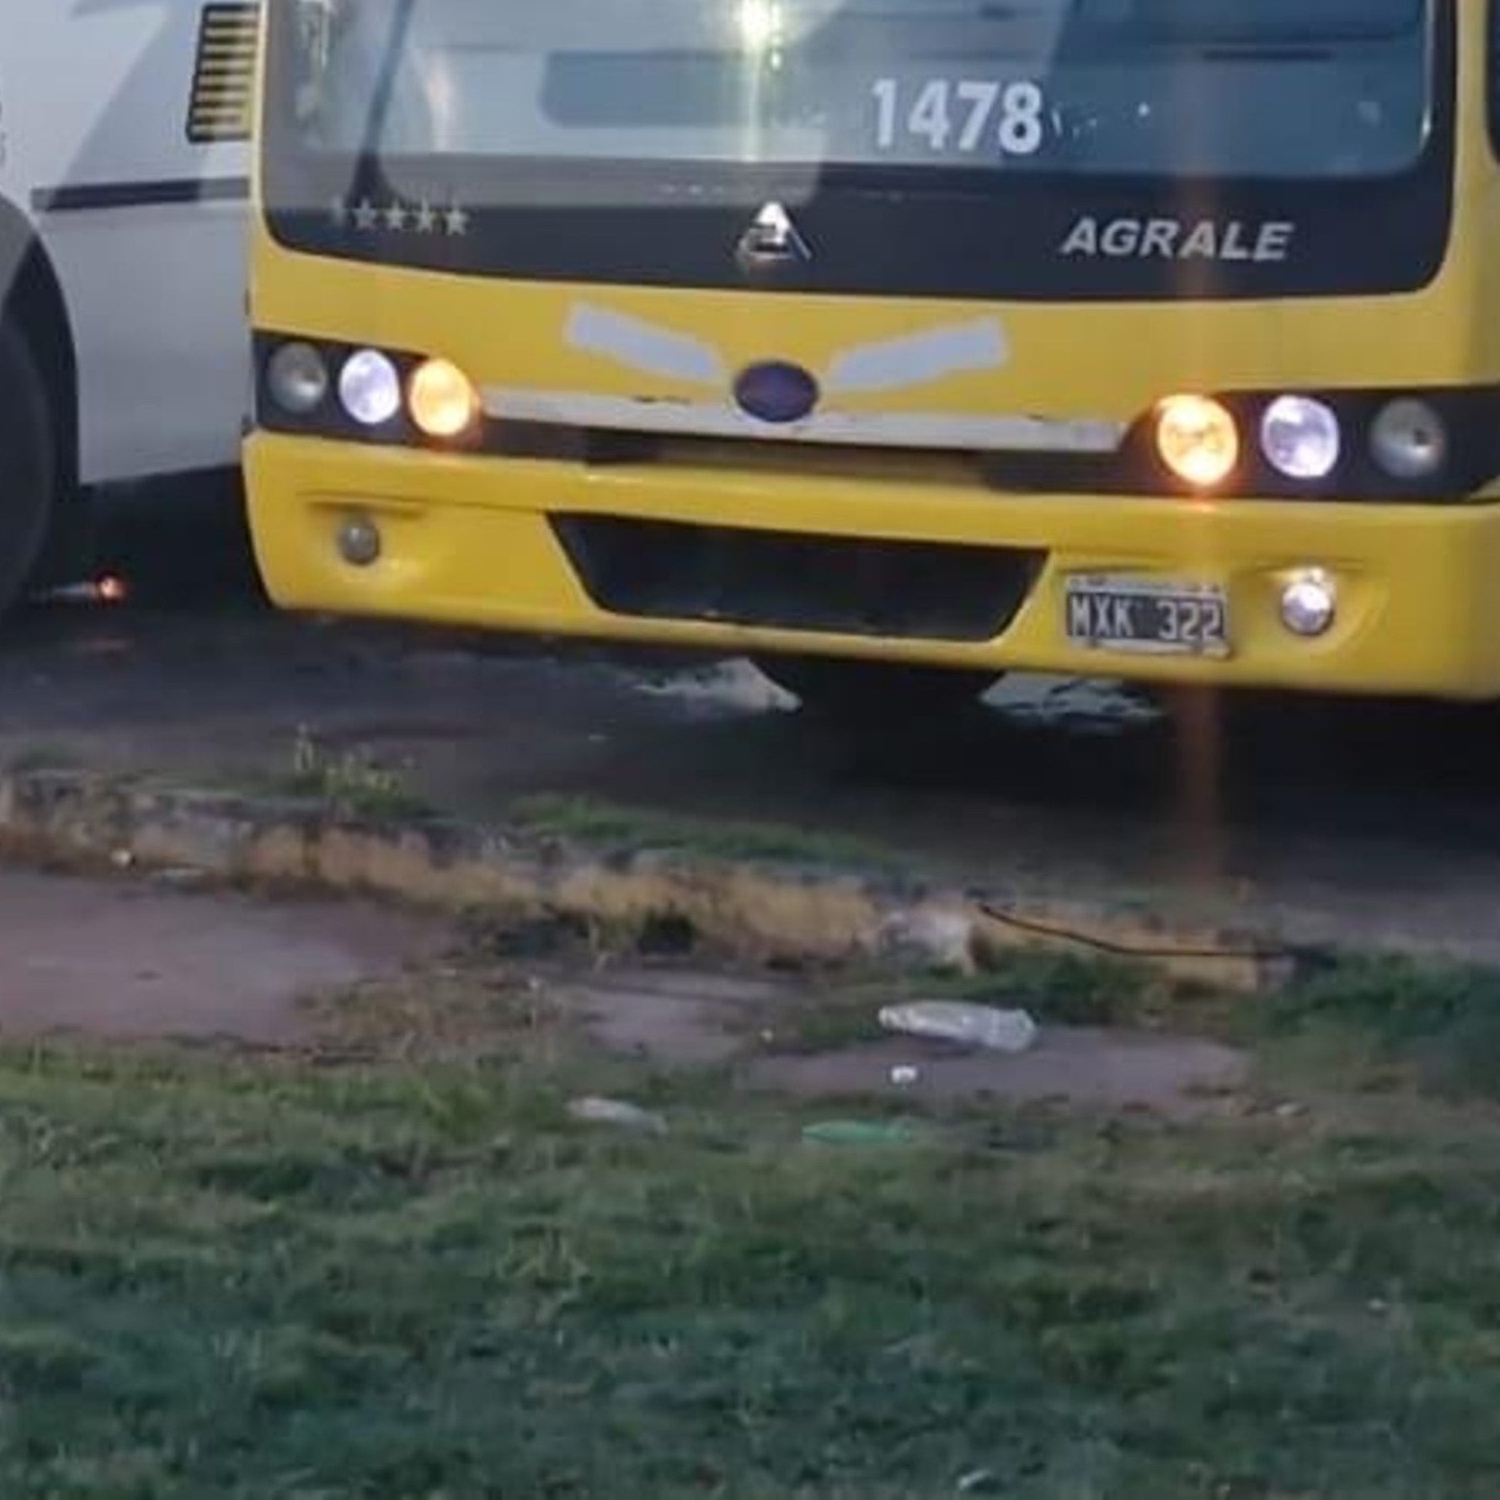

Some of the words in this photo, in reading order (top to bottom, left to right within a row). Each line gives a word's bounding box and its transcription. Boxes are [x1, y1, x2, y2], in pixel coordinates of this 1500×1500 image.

[872, 77, 1043, 154] 1478
[1060, 217, 1295, 262] AGRALE
[1071, 594, 1135, 637] MXK
[1156, 600, 1224, 641] 322
